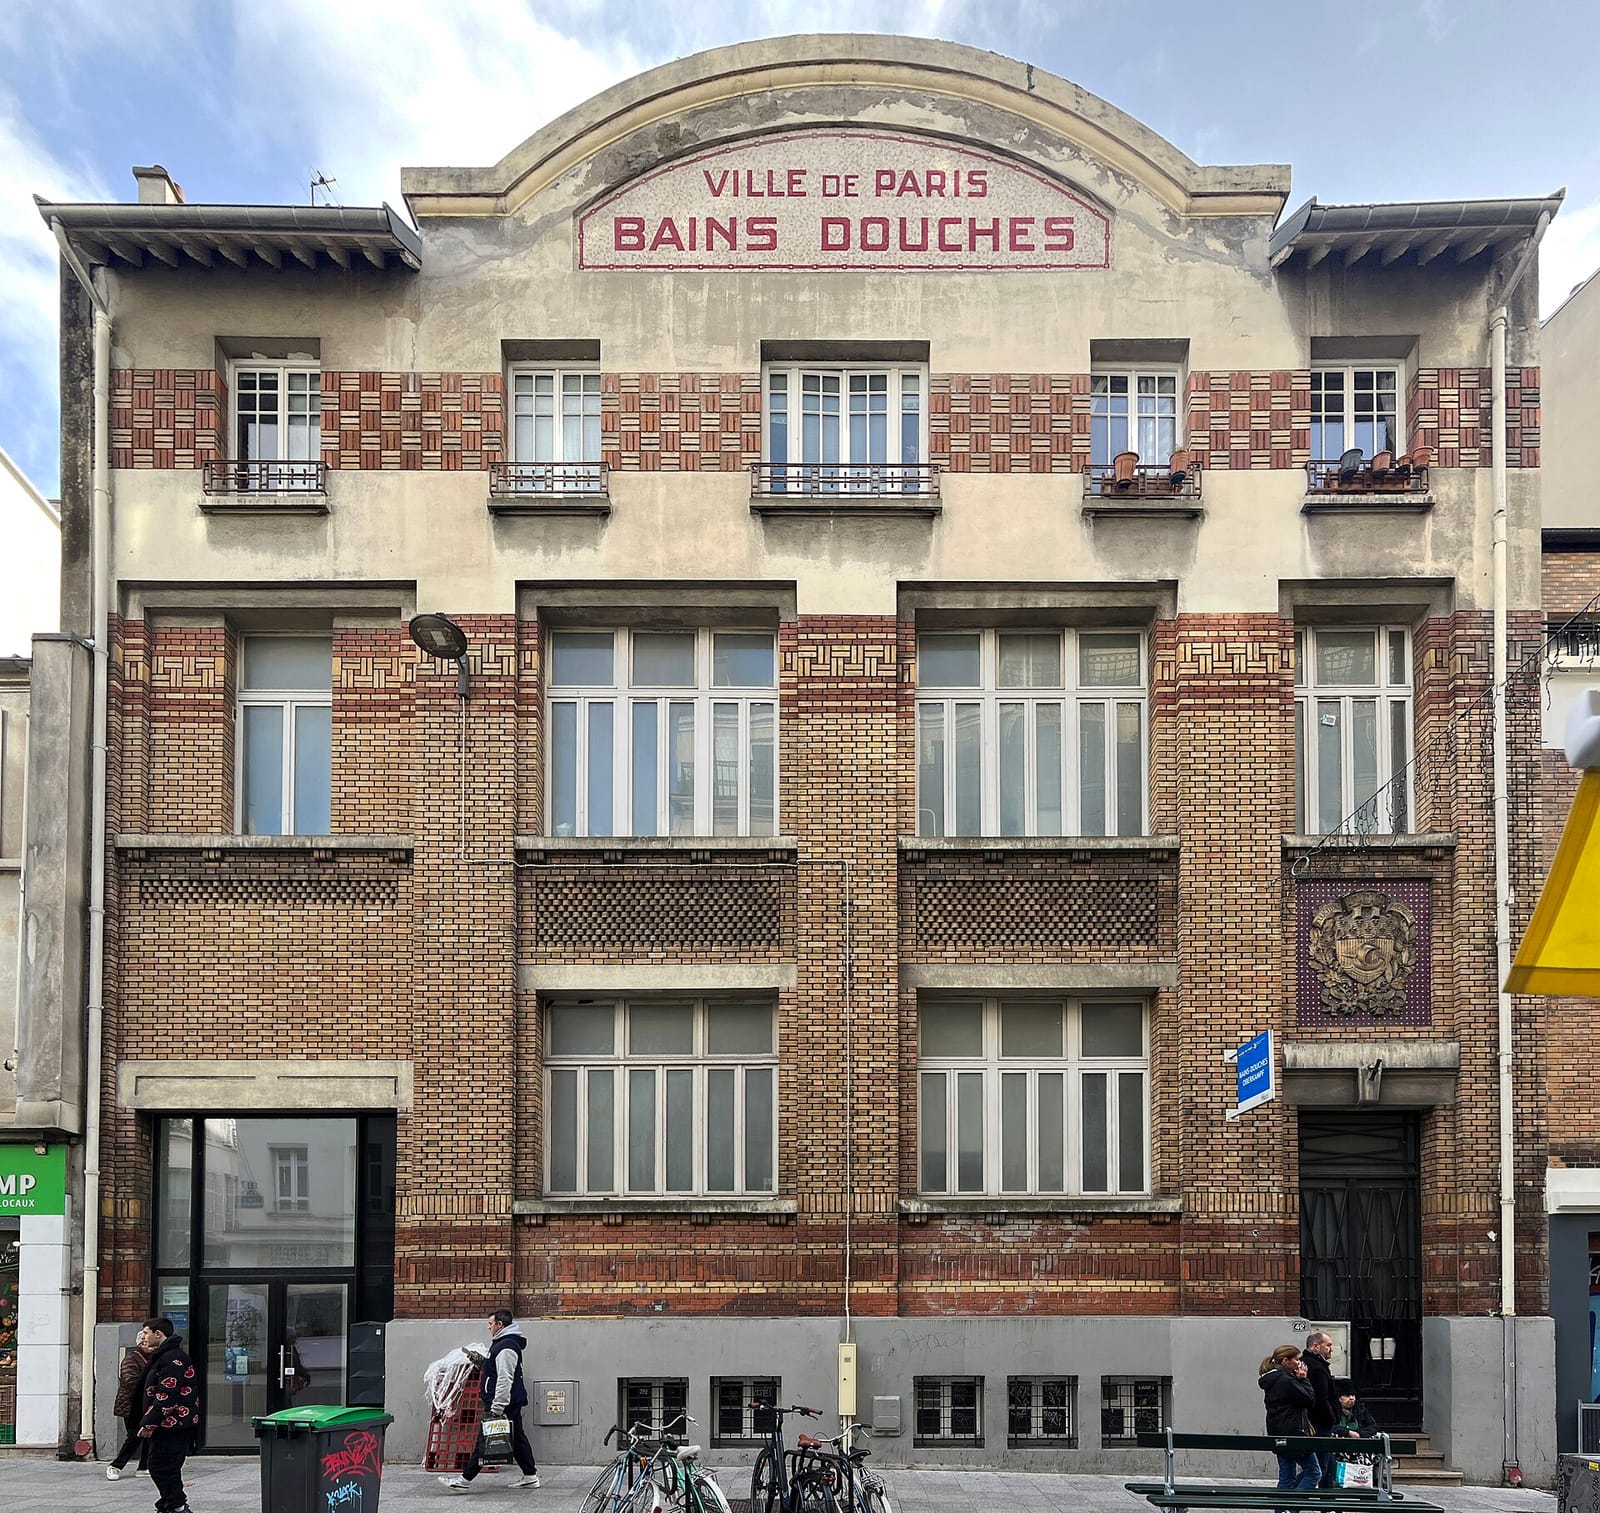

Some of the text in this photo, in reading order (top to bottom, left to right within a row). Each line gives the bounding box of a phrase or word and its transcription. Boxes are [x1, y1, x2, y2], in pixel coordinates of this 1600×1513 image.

[705, 169, 988, 198] VILLE DE PARIS
[614, 216, 1074, 252] BAINS DOUCHES
